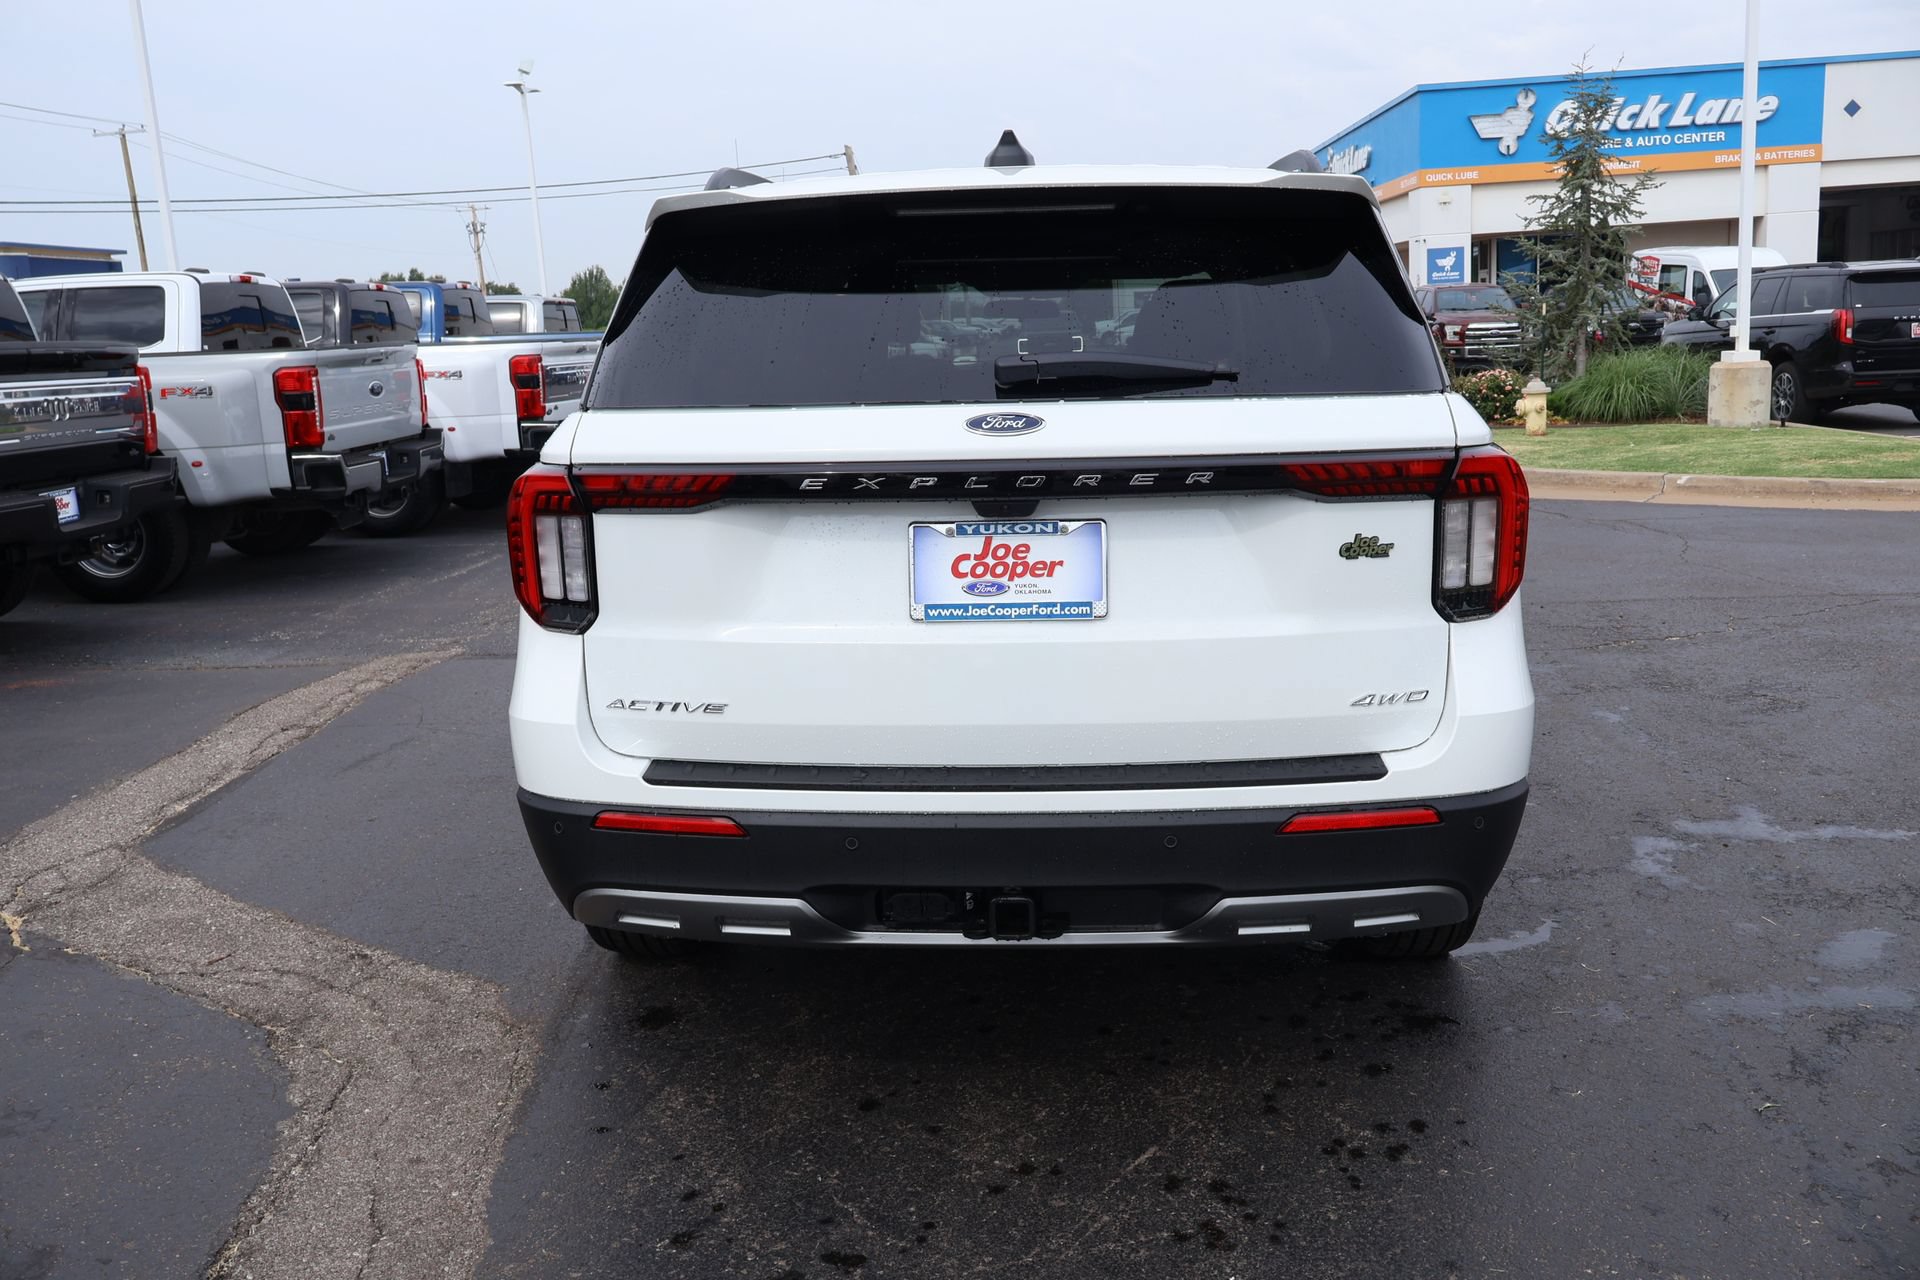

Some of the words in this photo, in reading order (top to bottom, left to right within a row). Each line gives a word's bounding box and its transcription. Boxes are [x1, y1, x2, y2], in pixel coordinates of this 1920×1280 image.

[1666, 92, 1780, 128] Lane
[1625, 137, 1633, 148] &
[1636, 134, 1671, 147] AUTO
[1675, 131, 1725, 145] CENTER
[1715, 154, 1741, 163] BRAK
[1764, 149, 1816, 160] BATTERIES
[1426, 173, 1453, 182] QUICK
[1455, 171, 1479, 180] LUBE
[160, 386, 213, 400] FX4
[982, 415, 1026, 429] Ford
[800, 471, 1214, 490] EXPLORER
[962, 523, 1054, 535] YUKON
[1352, 533, 1380, 548] Joe
[974, 536, 1031, 562] Joe
[1339, 543, 1395, 557] Cooper
[951, 553, 1064, 581] Cooper
[974, 583, 998, 593] Ford
[928, 604, 1091, 619] www.JoeCooperFord.com
[1350, 690, 1429, 707] 4WD
[606, 699, 729, 714] ACTIVE
